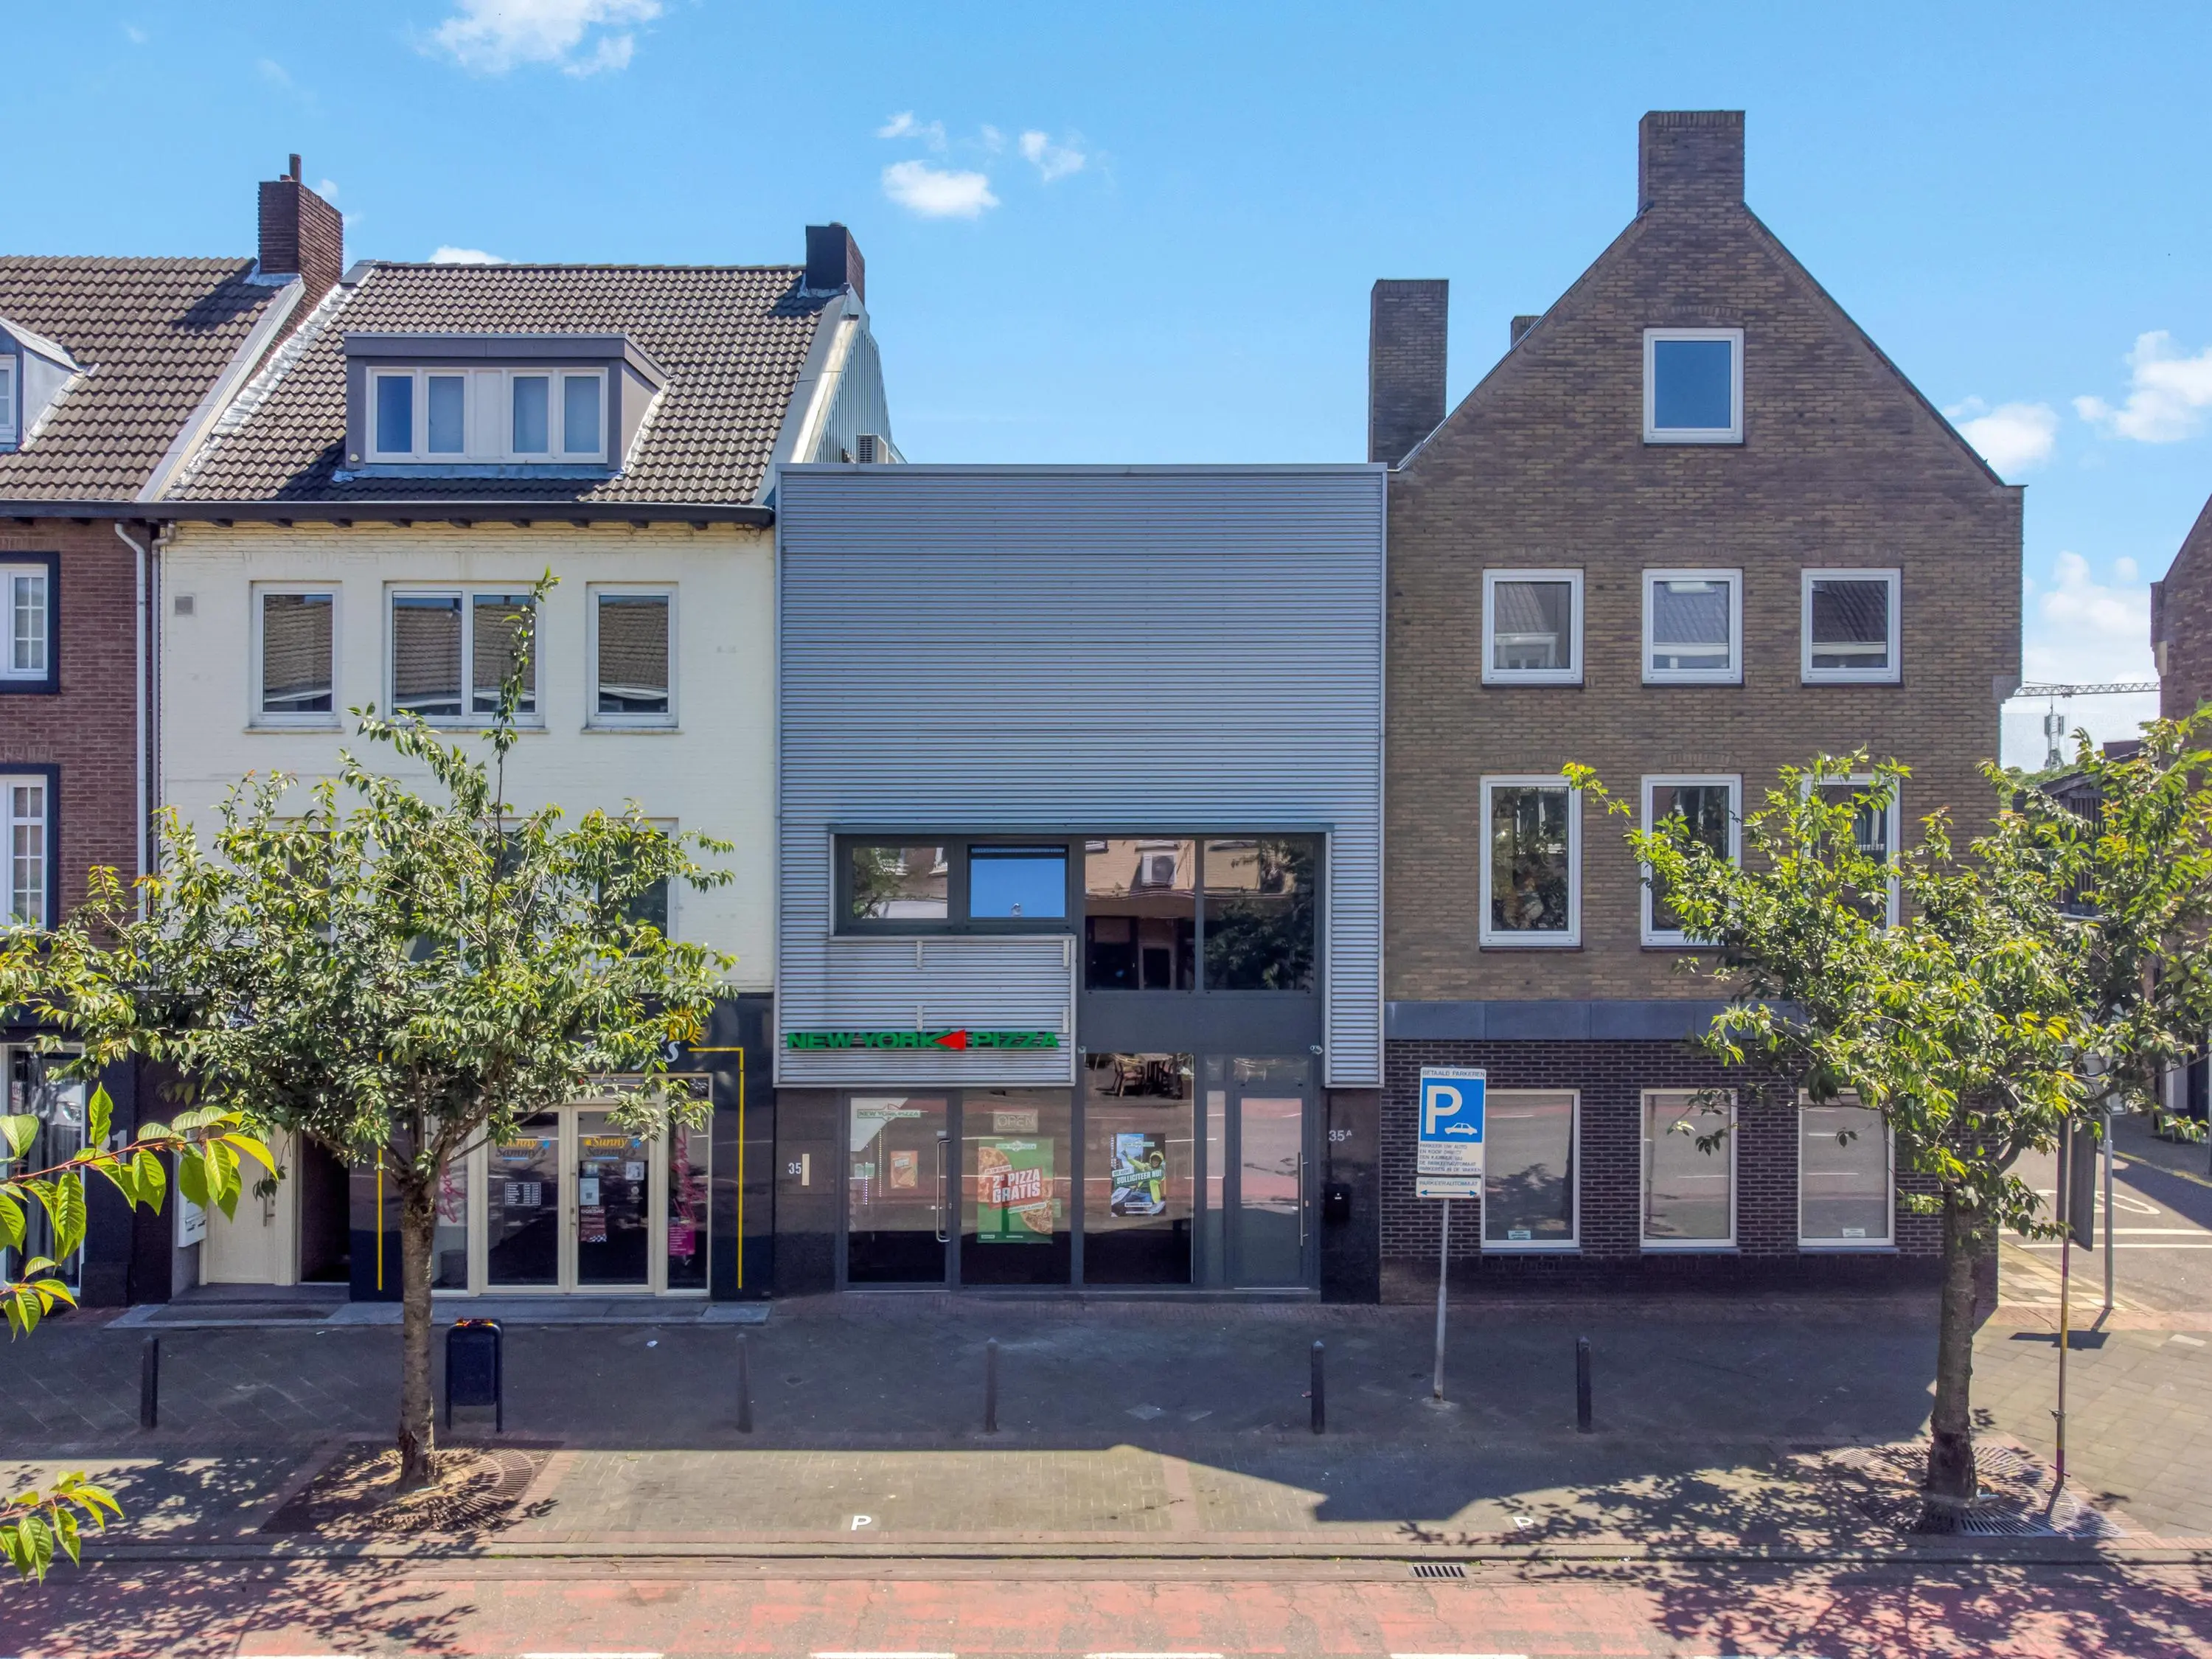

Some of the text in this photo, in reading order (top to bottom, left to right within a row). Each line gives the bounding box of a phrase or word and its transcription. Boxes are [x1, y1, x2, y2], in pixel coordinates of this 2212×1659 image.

[787, 1029, 1060, 1051] NEW YORK PIZZA
[1425, 1085, 1463, 1134] P
[997, 1115, 1034, 1127] OPEN
[593, 1138, 628, 1148] Sunny
[495, 1147, 546, 1159] Sammy's
[788, 1163, 801, 1174] 35
[1007, 1169, 1040, 1186] PIZZA
[1116, 1172, 1151, 1184] SOLLICITEER
[992, 1182, 1040, 1203] GRATIS
[851, 1515, 872, 1531] P
